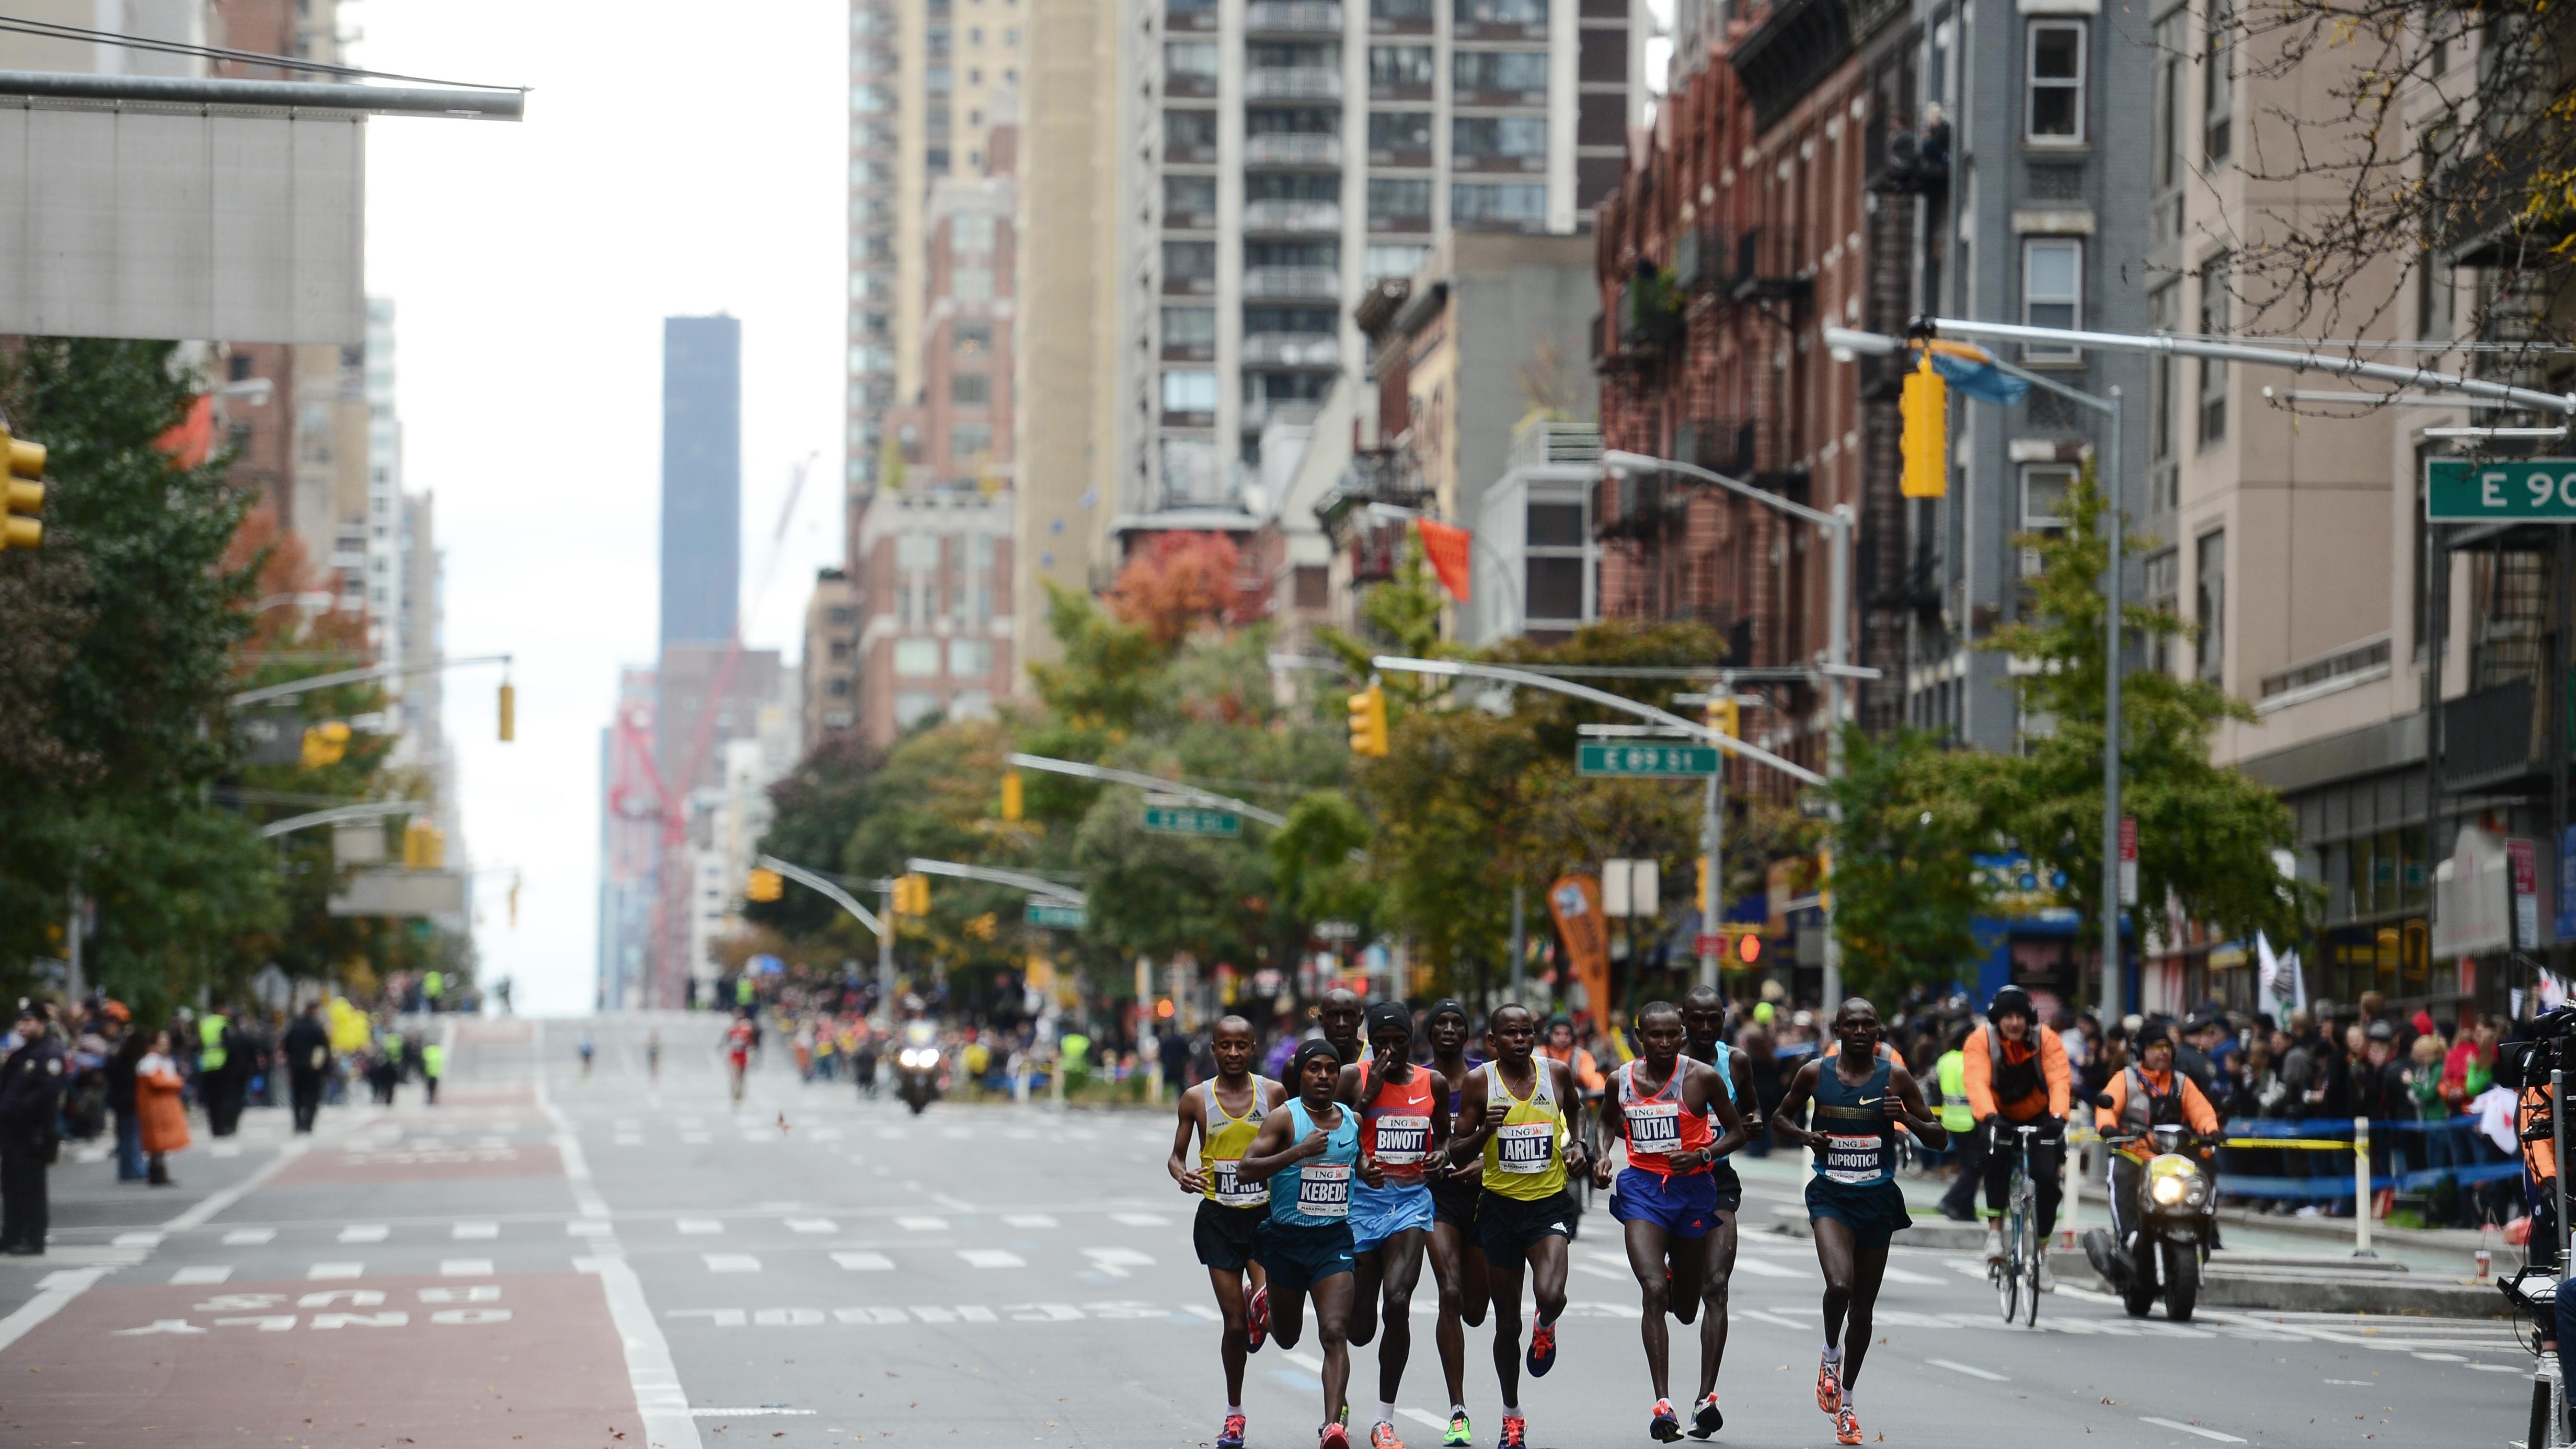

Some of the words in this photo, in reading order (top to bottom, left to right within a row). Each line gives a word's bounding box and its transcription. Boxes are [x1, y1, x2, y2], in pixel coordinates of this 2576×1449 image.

[2482, 472, 2508, 507] E
[2527, 472, 2576, 508] 90
[1604, 748, 1619, 769] E
[1630, 1118, 1675, 1140] MUTAI
[1377, 1131, 1425, 1149] BIWOTT
[1505, 1137, 1547, 1160] ARILE
[1828, 1153, 1878, 1167] KIPROTICH
[1301, 1182, 1348, 1201] KEBEDE
